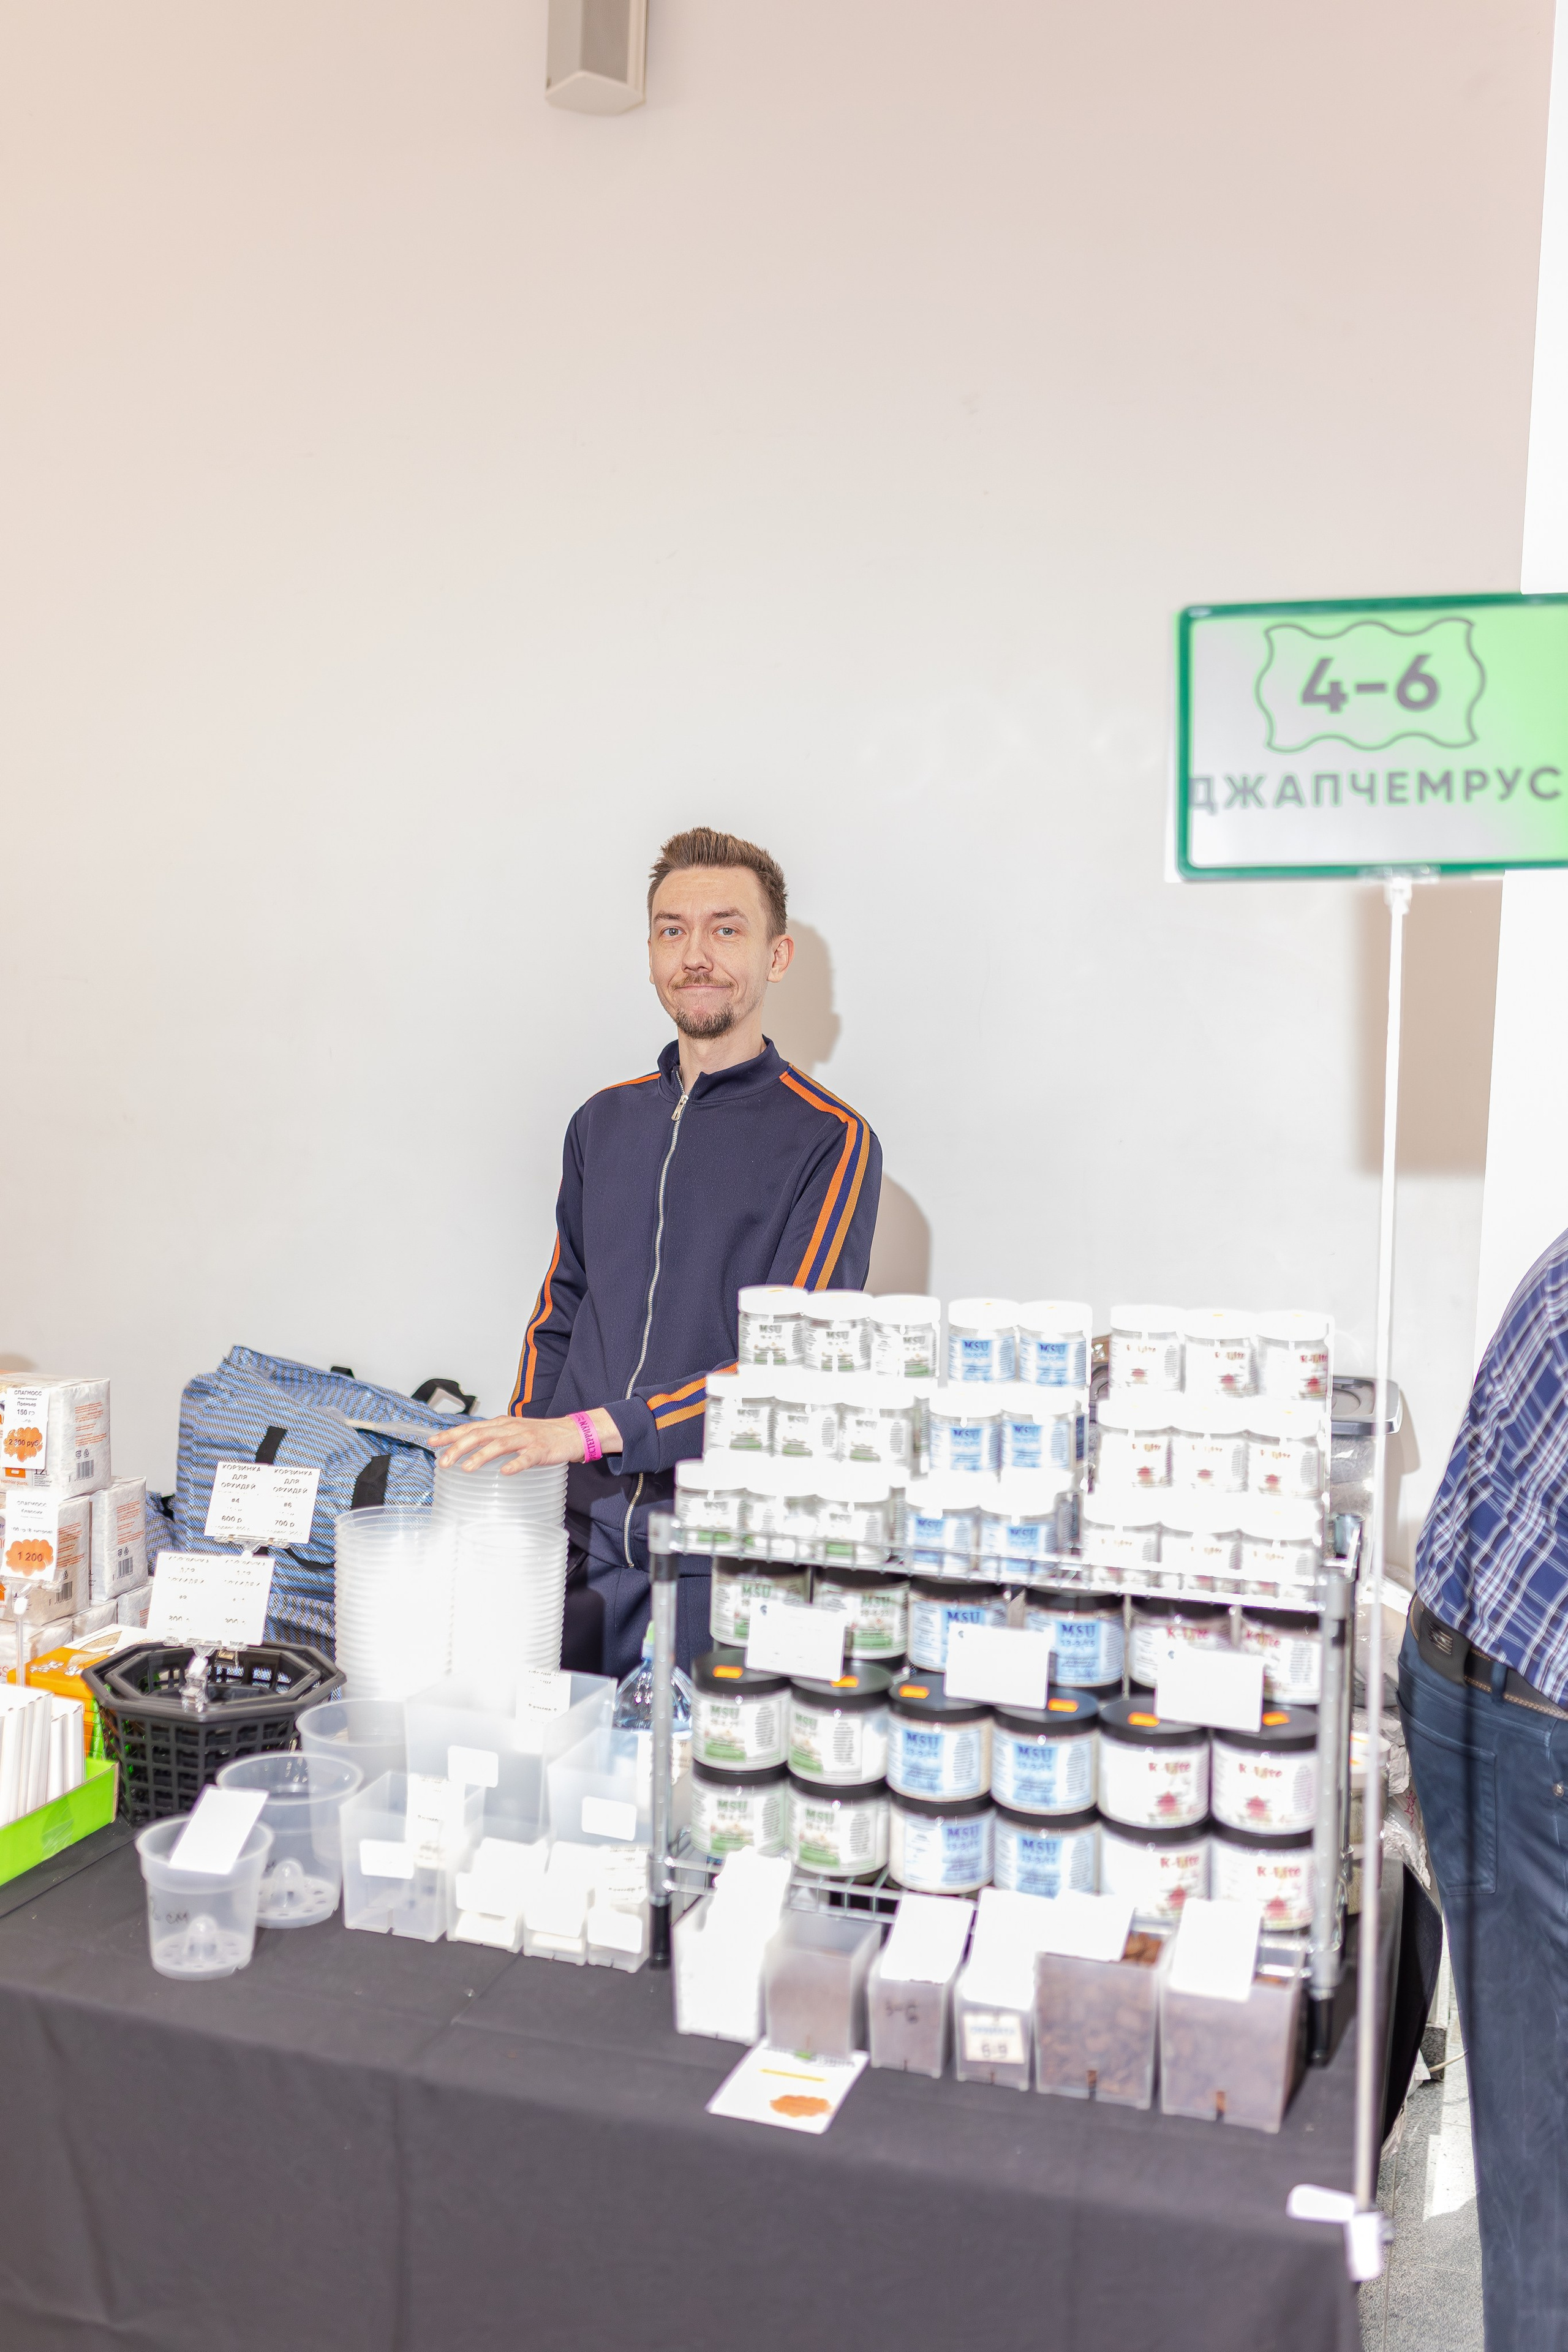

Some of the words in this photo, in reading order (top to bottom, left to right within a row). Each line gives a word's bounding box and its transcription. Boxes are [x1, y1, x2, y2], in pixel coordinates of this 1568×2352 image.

[1300, 654, 1440, 713] 4-6
[25, 1552, 43, 1562] 200
[947, 1611, 981, 1624] MSU
[1061, 1624, 1096, 1638] MSU
[905, 1732, 939, 1750] MSU
[1017, 1746, 1052, 1762] MSU
[1022, 1839, 1057, 1855] MSU
